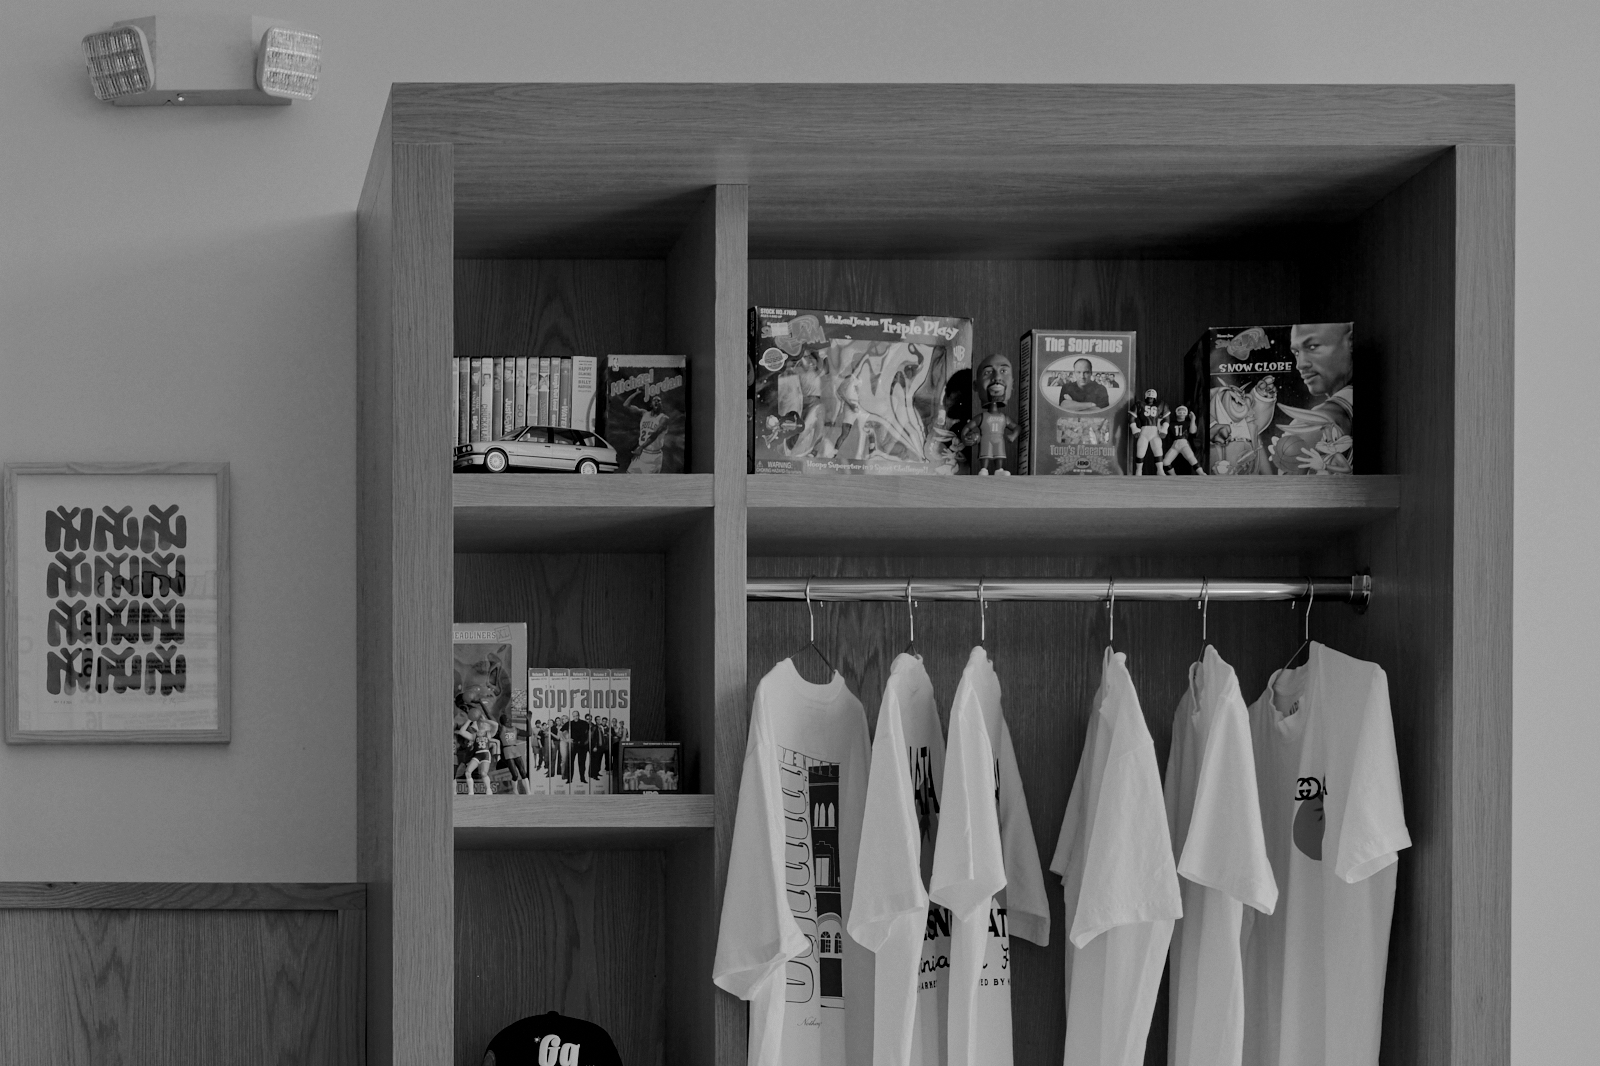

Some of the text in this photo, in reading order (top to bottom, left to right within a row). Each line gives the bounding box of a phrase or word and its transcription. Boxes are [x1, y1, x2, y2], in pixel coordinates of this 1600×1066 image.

[824, 315, 959, 340] Michael Jordan Triple Play
[1044, 337, 1123, 354] The Sopranos
[1219, 361, 1293, 373] SNOW GLOBE
[610, 368, 654, 397] Michael
[644, 375, 682, 403] Jordan
[1144, 405, 1158, 417] 56
[1174, 425, 1183, 436] 11
[1050, 444, 1115, 457] Tony's Macaroni
[806, 460, 827, 470] Hoops
[454, 631, 496, 640] EADLINERS
[533, 688, 628, 712] Sopranos
